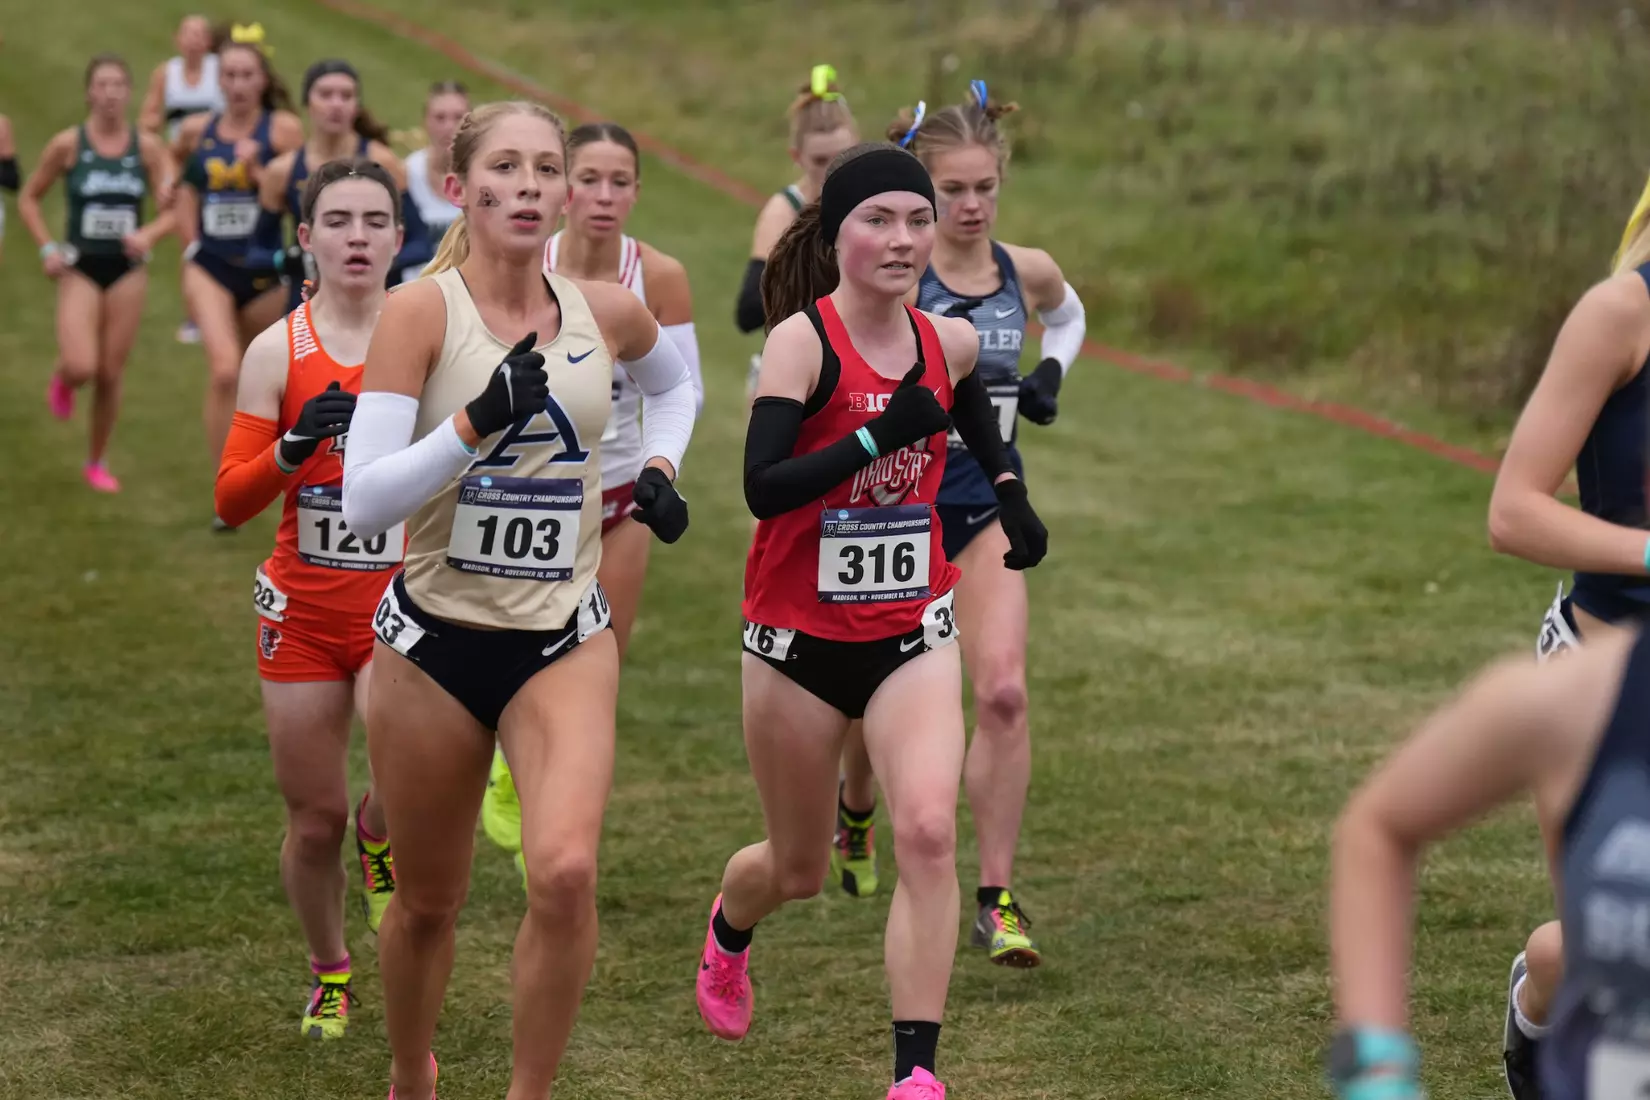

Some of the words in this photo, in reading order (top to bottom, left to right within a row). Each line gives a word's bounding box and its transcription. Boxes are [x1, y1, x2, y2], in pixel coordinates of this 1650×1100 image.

[977, 328, 1022, 350] LER
[468, 391, 591, 470] A
[477, 491, 501, 501] CROSS
[501, 493, 532, 502] COUNTRY
[531, 494, 583, 504] CHAMPIONSHIPS
[860, 522, 888, 530] COUNTRY
[887, 518, 930, 529] CHAMPIONSHIPS
[477, 515, 561, 561] 103
[503, 568, 537, 578] NOVEMBER
[838, 541, 915, 585] 316
[870, 592, 898, 600] NOVEMBER
[376, 597, 405, 644] 03
